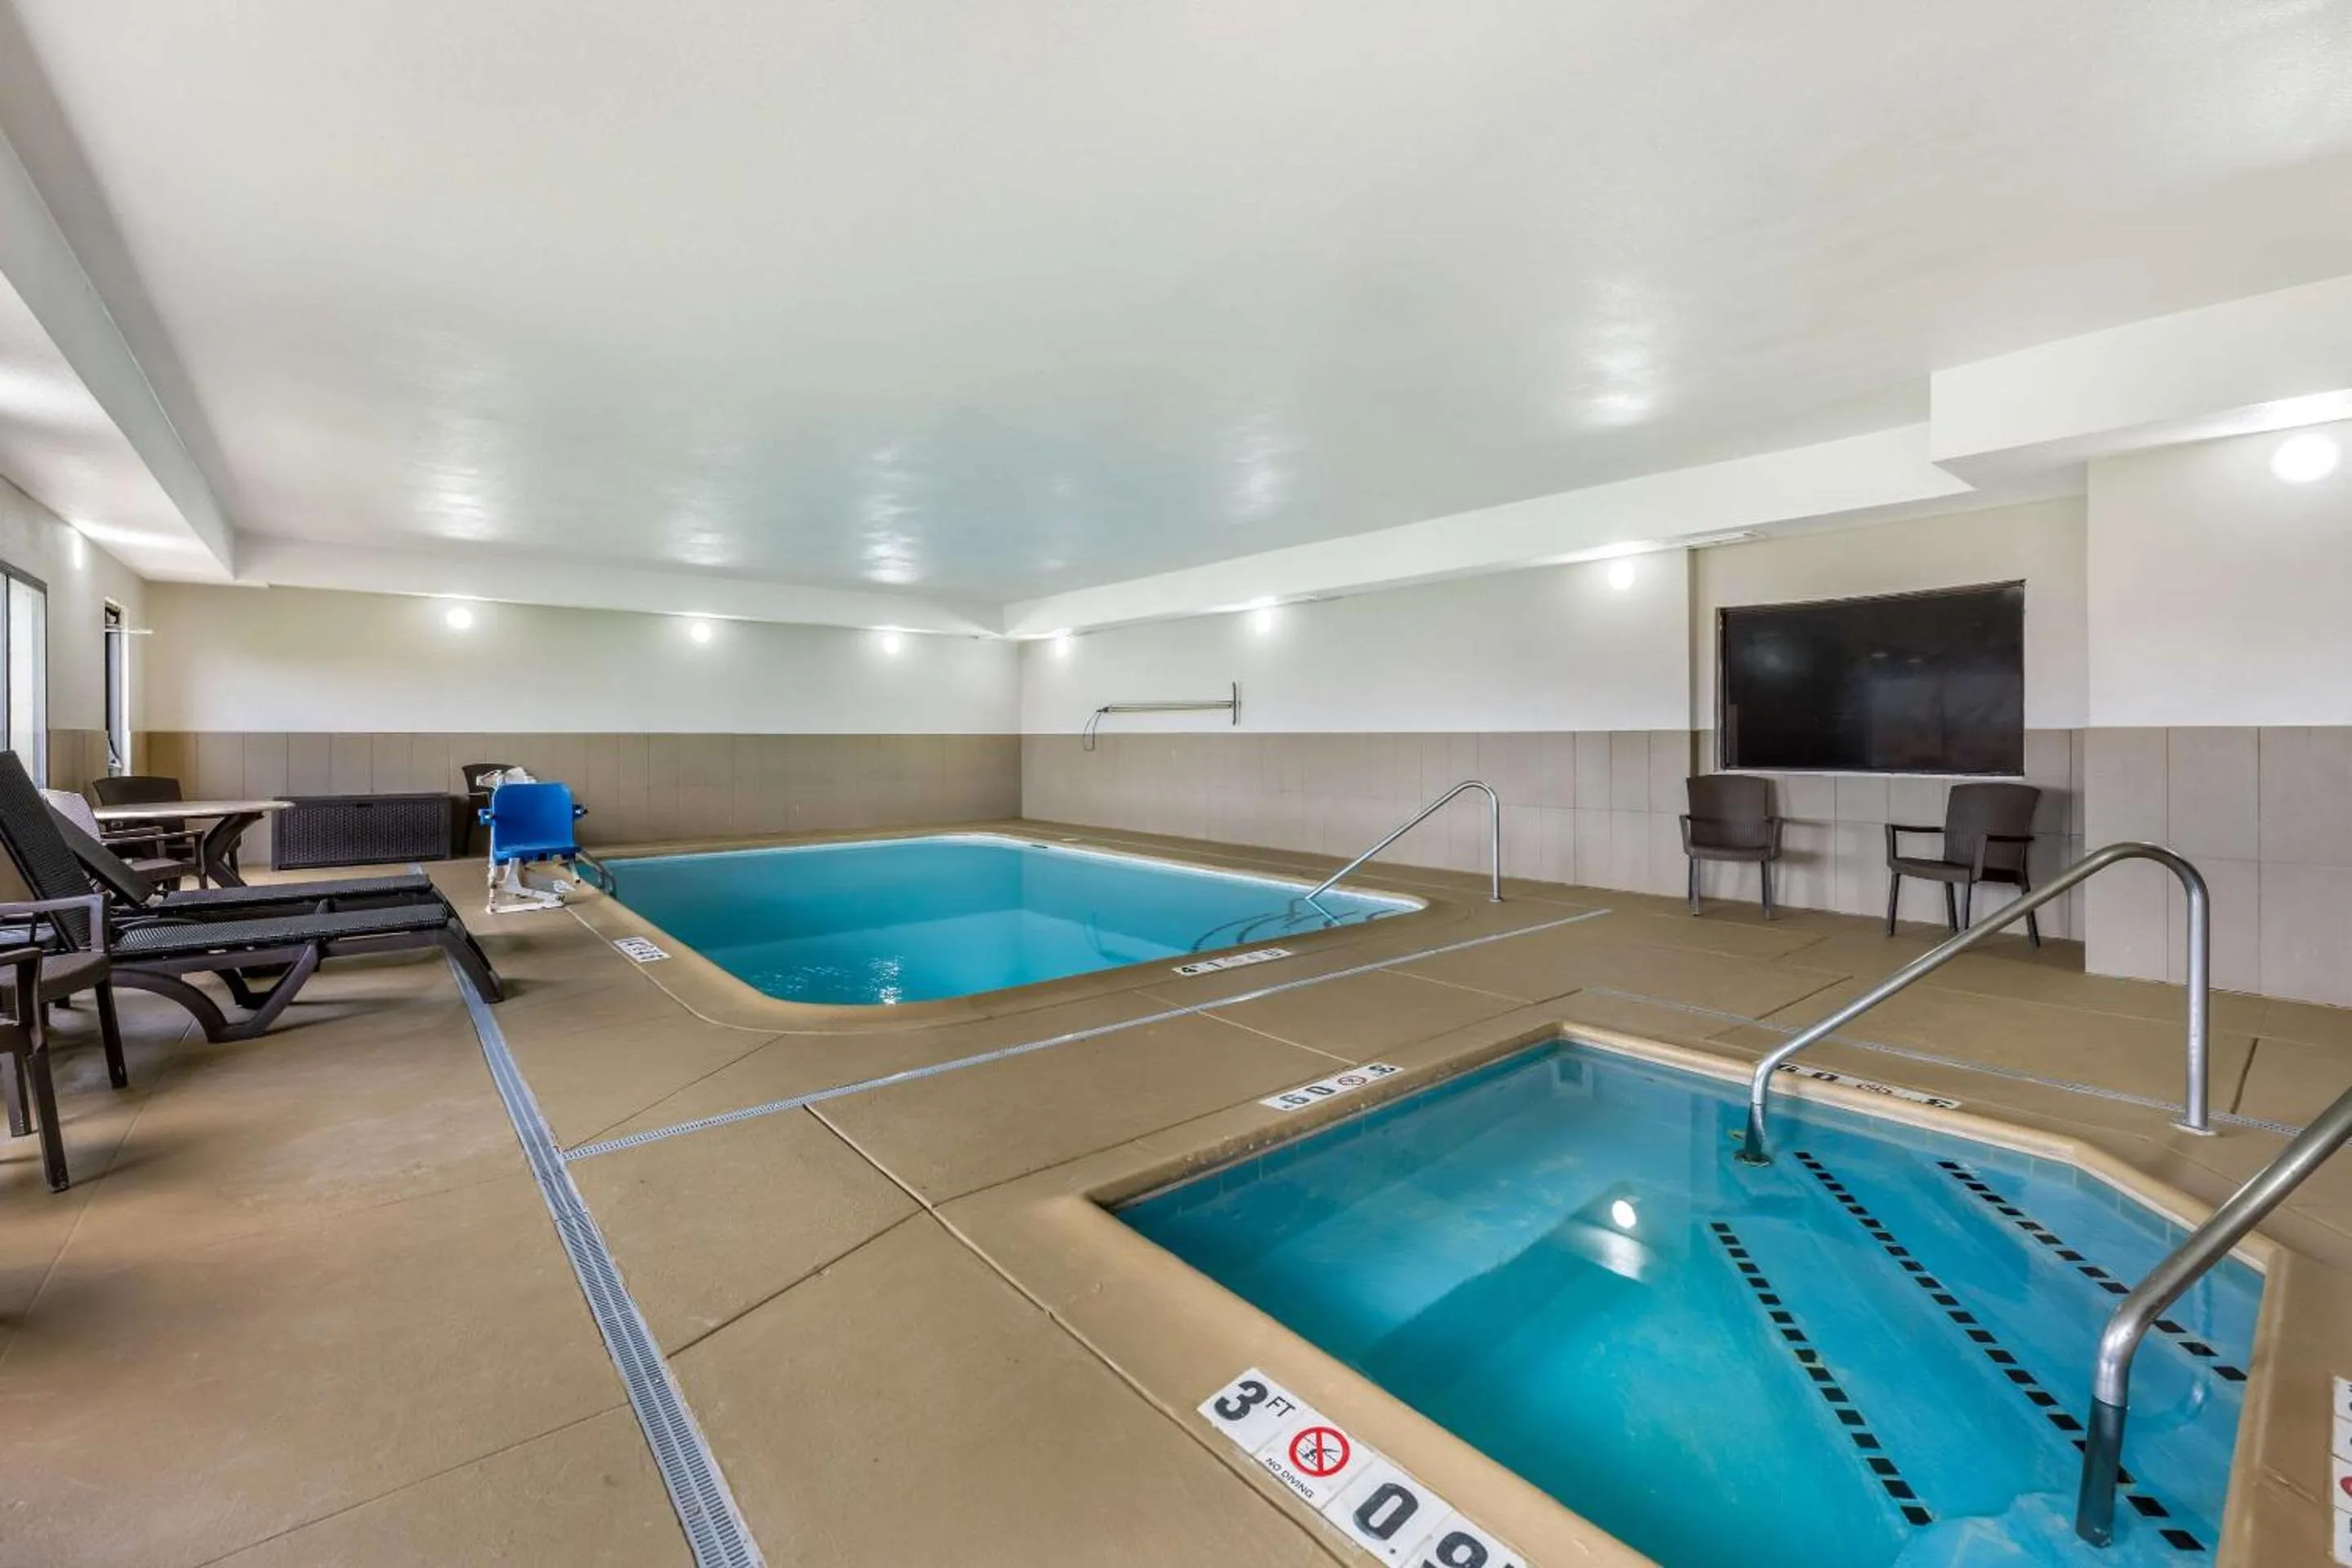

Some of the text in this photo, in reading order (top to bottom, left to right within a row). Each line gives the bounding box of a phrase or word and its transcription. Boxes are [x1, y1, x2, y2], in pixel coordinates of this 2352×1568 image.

[1214, 1380, 1296, 1421] 3 FT
[1265, 1456, 1316, 1499] NO DIVING
